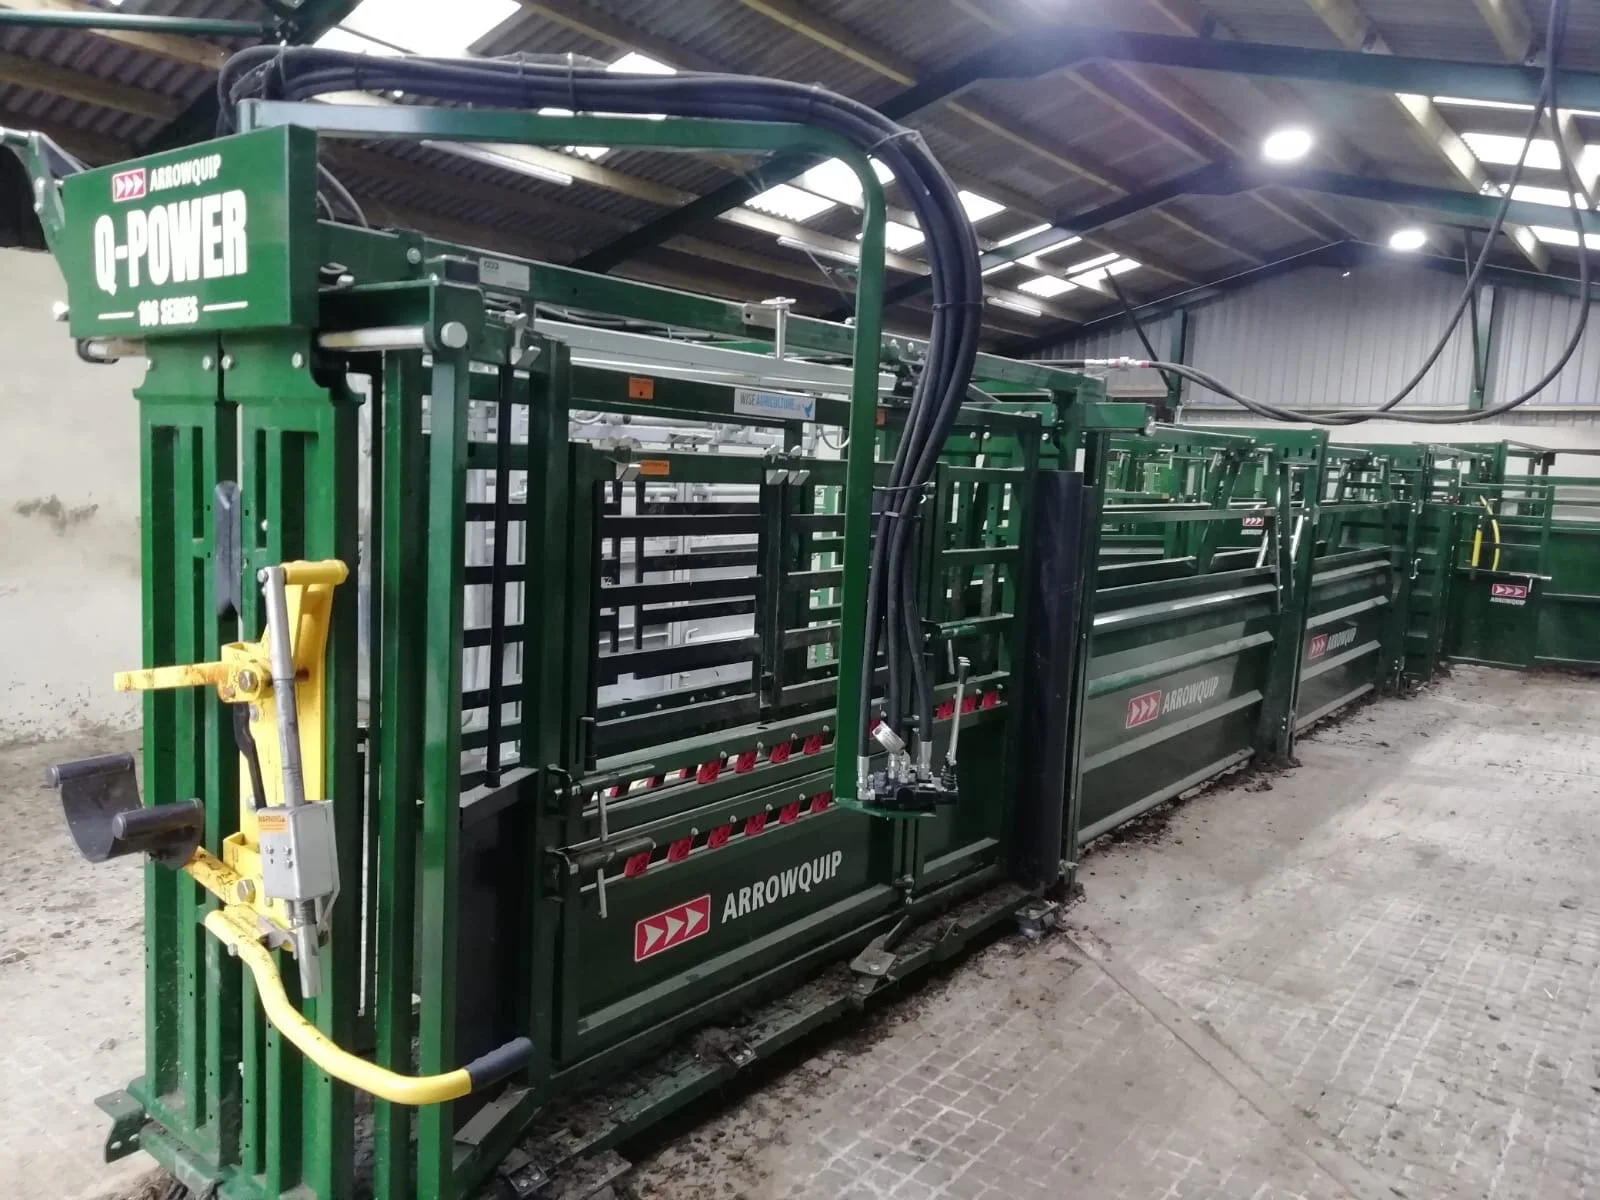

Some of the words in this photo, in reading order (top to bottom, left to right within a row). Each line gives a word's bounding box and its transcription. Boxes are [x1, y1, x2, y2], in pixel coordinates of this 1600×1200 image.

[149, 154, 222, 192] ARROWQUIP
[94, 189, 248, 296] Q-POWER
[160, 295, 199, 326] SERIES
[1161, 676, 1219, 714] ARROWQUIP
[721, 850, 842, 924] ARROWQUIP
